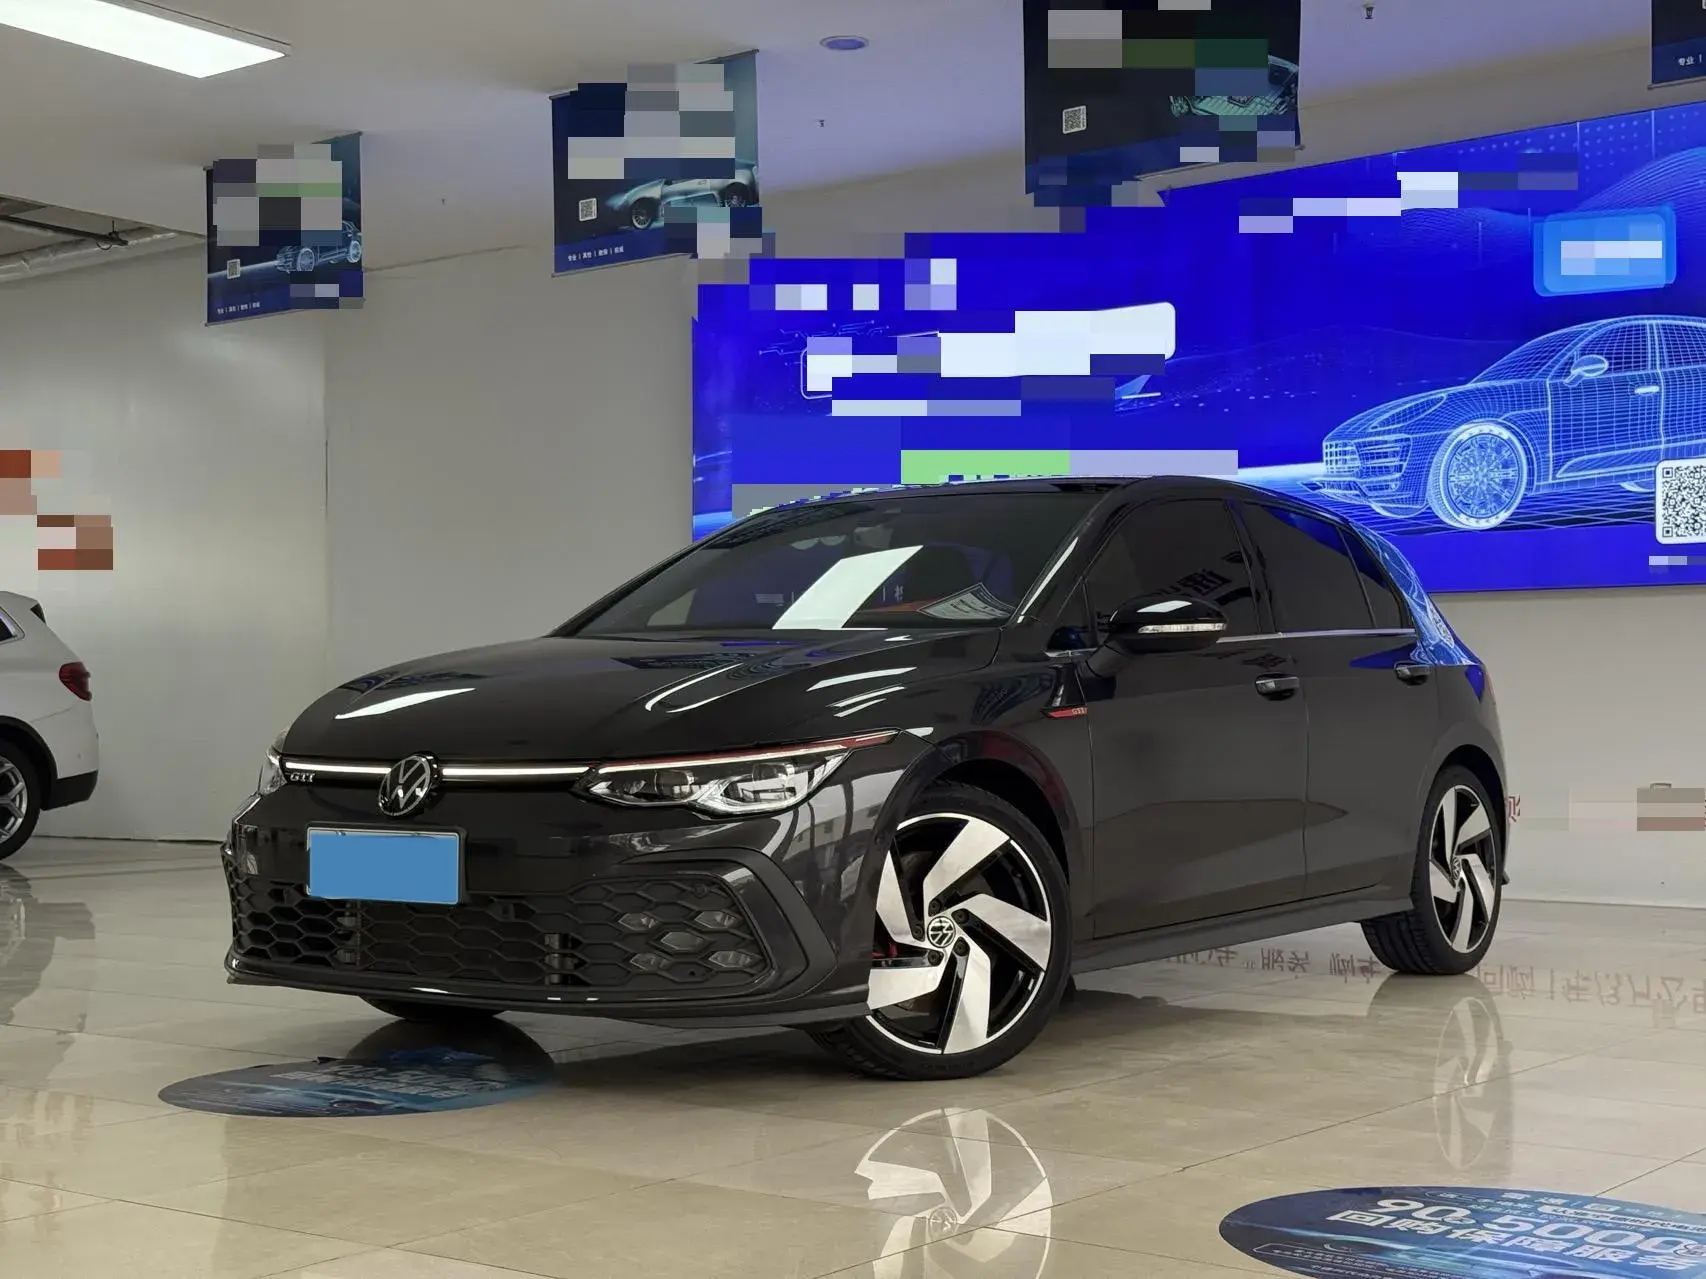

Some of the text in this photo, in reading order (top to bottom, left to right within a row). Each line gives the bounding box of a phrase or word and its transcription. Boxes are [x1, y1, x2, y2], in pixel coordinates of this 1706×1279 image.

[289, 772, 315, 783] GTI
[1326, 1209, 1699, 1271] 回购保障服务
